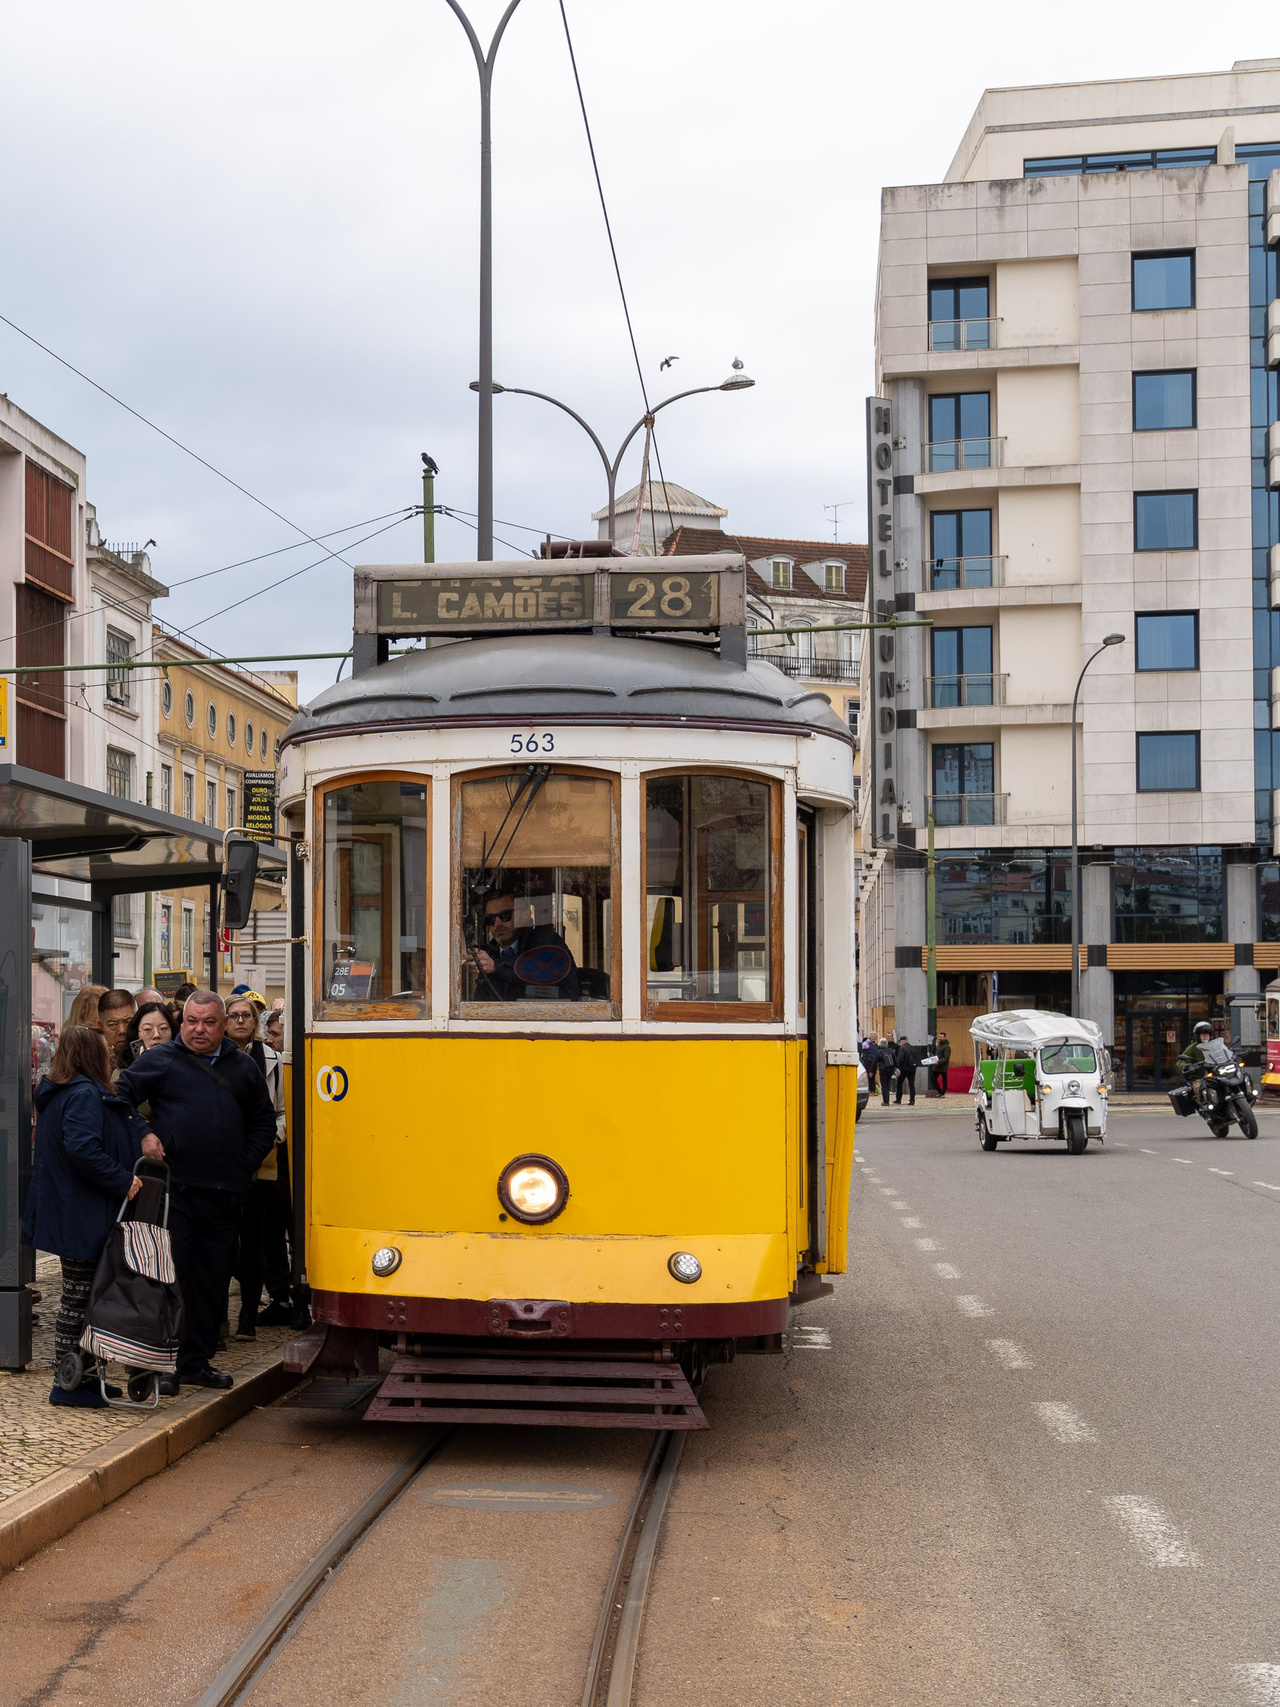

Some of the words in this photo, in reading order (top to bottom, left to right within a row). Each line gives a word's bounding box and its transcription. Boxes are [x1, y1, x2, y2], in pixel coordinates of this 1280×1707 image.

[875, 406, 892, 577] HOTEL
[392, 593, 418, 619] L.
[437, 588, 583, 619] CAMÕES
[627, 576, 692, 618] 28
[877, 598, 897, 840] MUNDIAL
[510, 733, 555, 753] 563
[334, 967, 350, 976] 28E
[330, 983, 347, 996] 05
